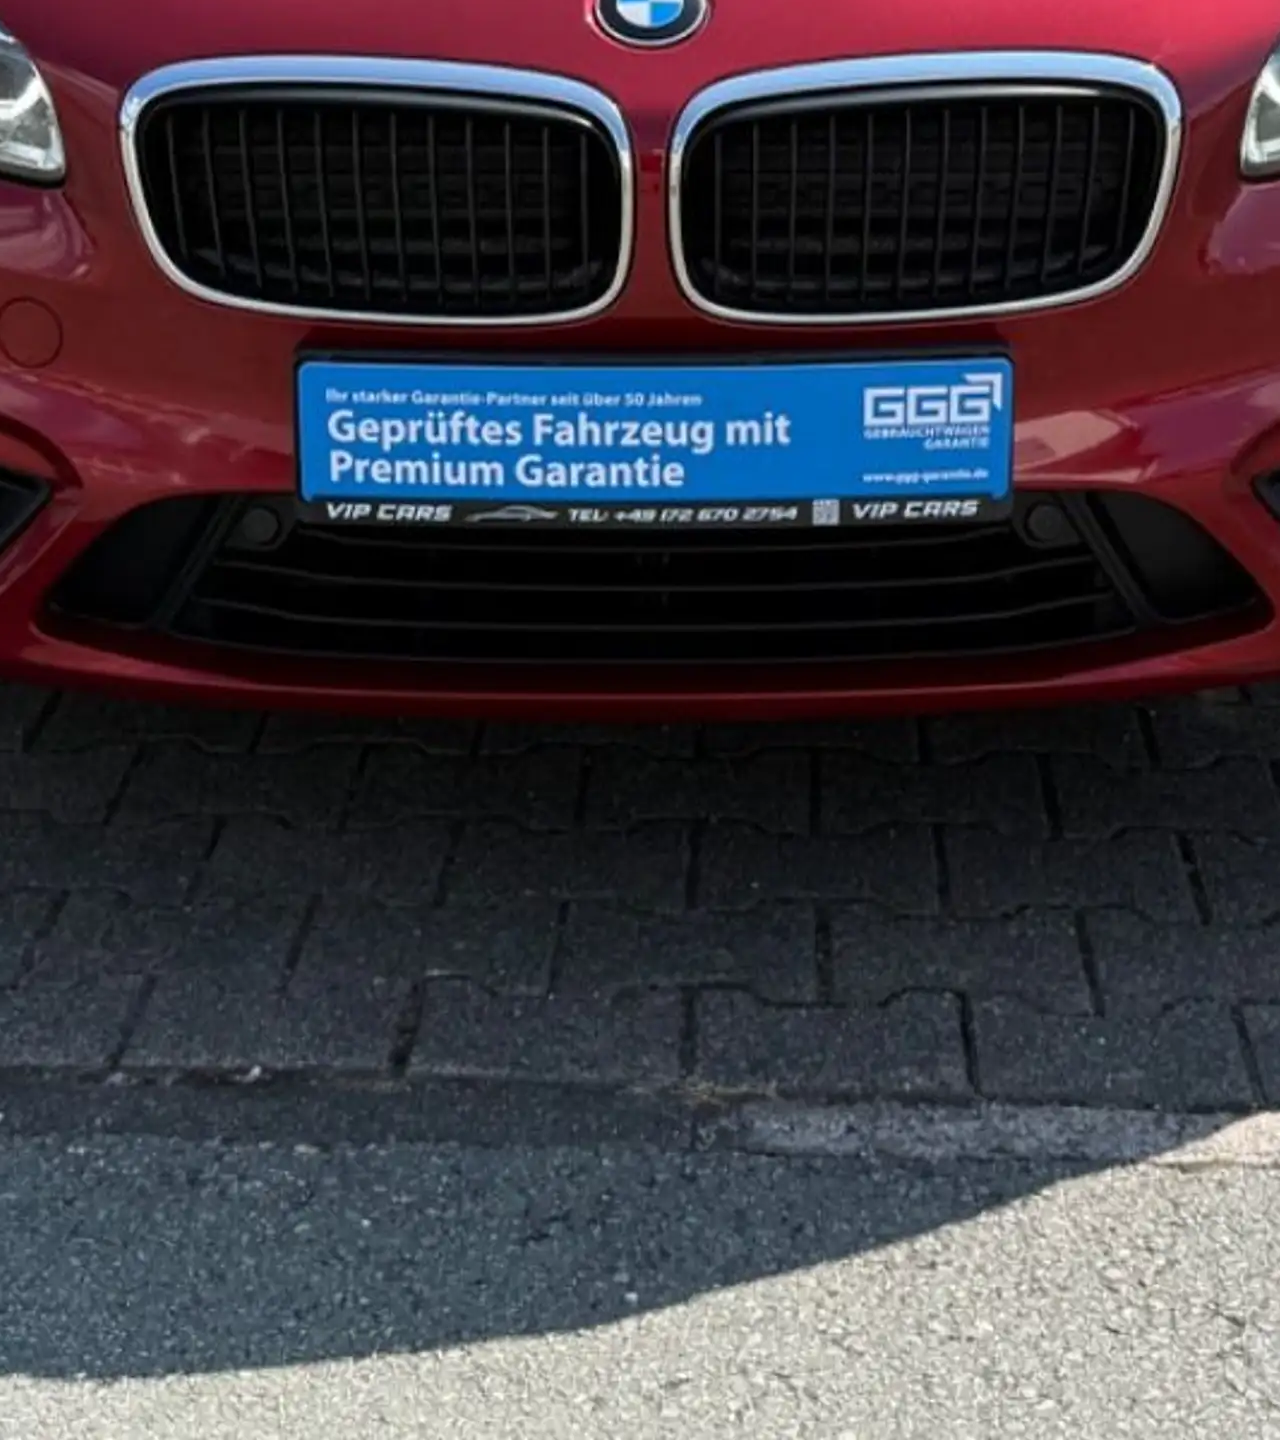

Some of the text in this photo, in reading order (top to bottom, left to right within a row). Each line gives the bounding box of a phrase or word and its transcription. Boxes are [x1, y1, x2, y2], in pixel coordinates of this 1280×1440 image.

[325, 388, 703, 407] Ihr starker Garantie-Partner seit über 50 Jahren
[863, 386, 992, 426] GGG
[327, 409, 792, 455] Geprüftes Fahrzeug mit
[863, 425, 992, 440] GEBRAUCHTWAGEN
[330, 449, 686, 488] Premium Garantie
[326, 502, 453, 522] VIP CARS
[852, 498, 980, 520] VIP CARS
